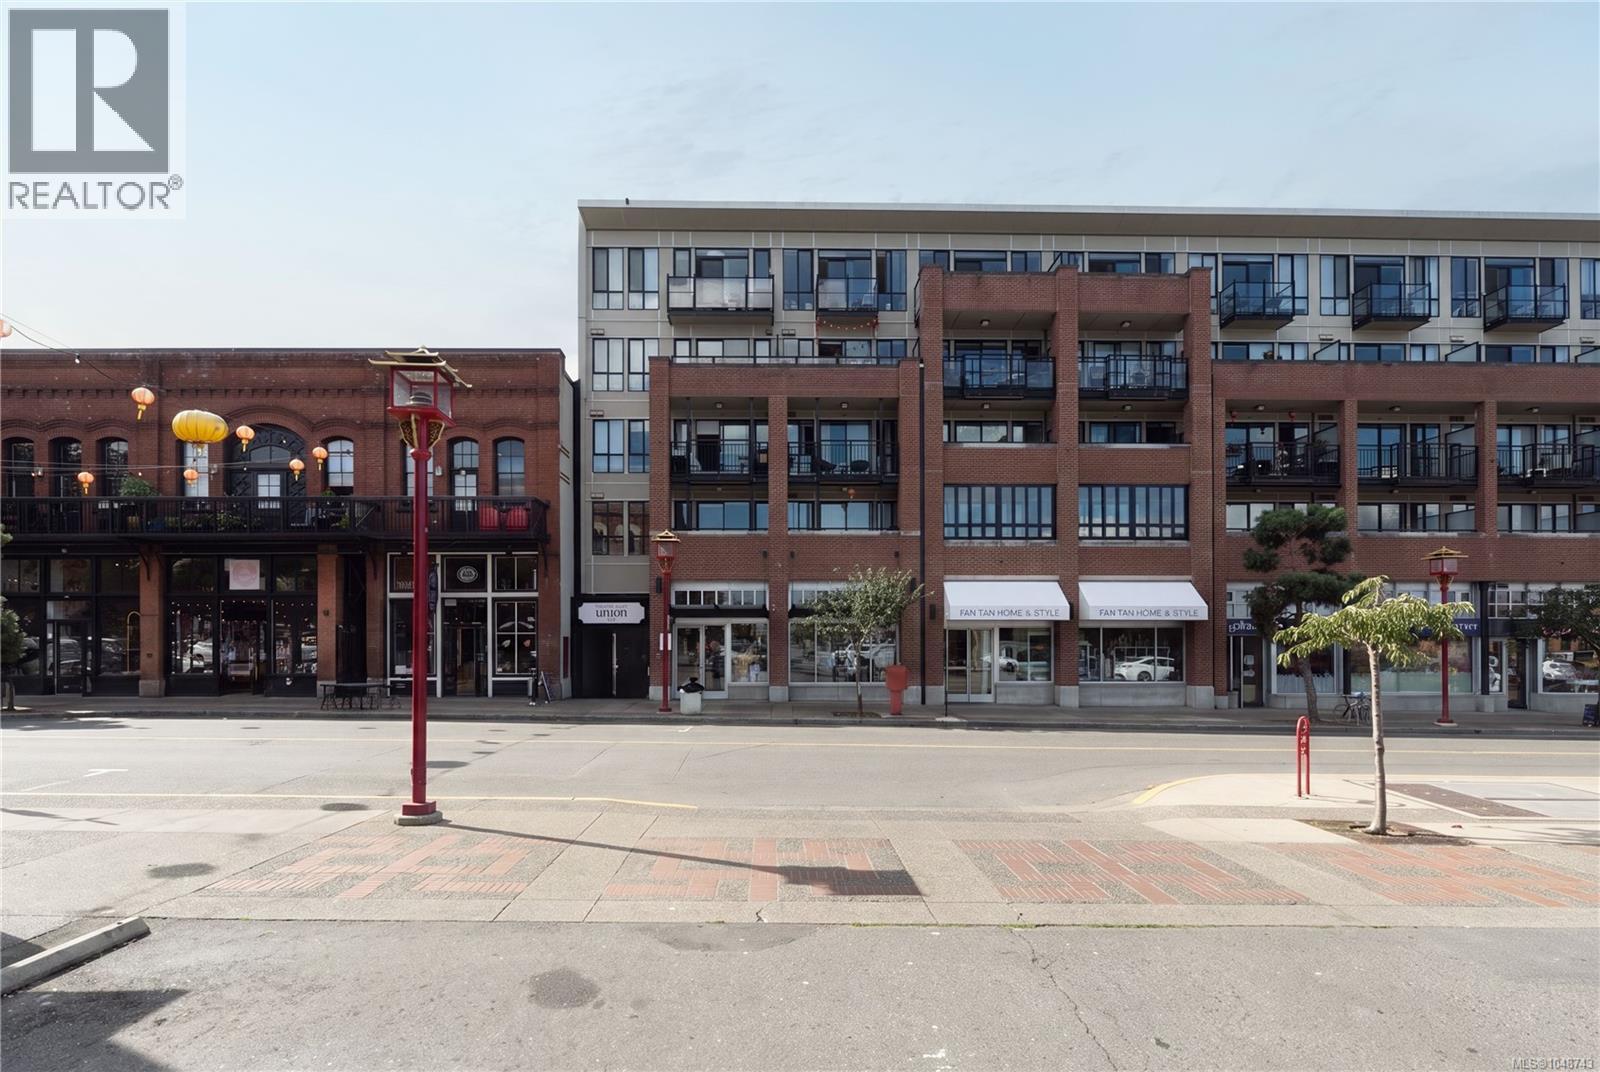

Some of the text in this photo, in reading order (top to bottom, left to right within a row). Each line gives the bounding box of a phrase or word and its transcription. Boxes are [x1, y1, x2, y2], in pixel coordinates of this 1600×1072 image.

[596, 609, 627, 617] union
[960, 609, 1059, 617] FAN TAN HOME & STYLE
[1099, 609, 1198, 617] FAN TAN HOME & STYLE
